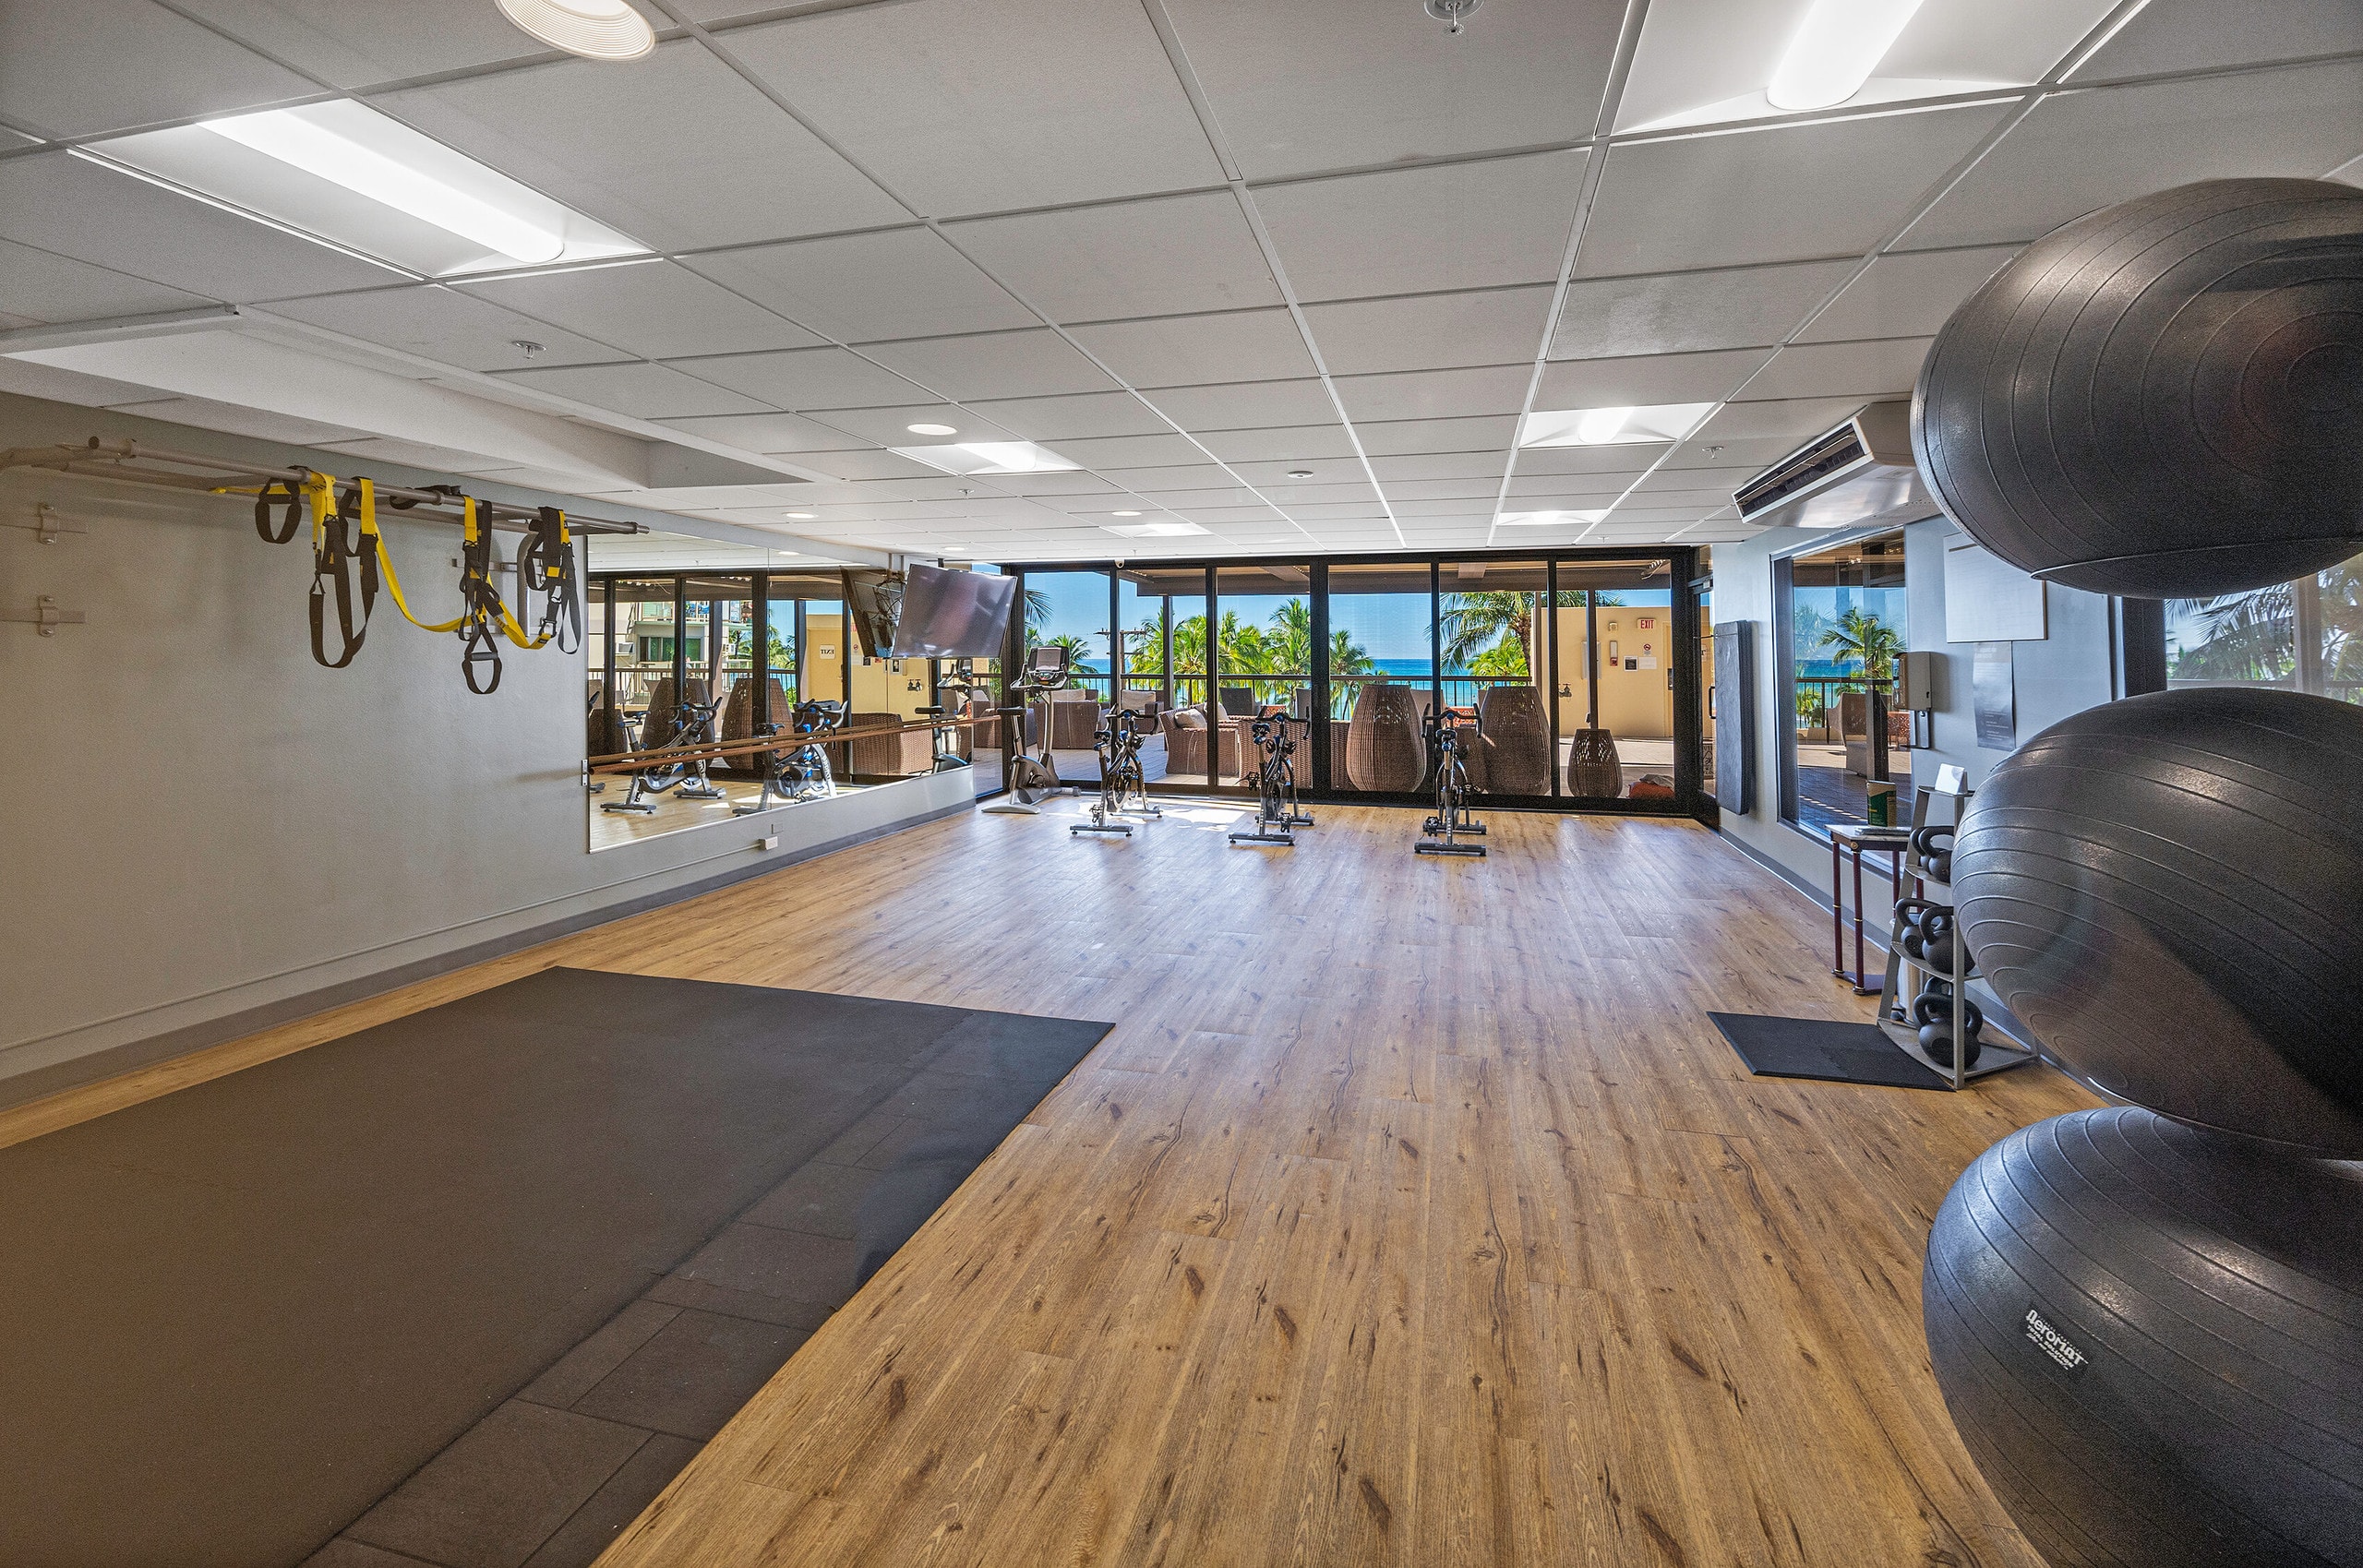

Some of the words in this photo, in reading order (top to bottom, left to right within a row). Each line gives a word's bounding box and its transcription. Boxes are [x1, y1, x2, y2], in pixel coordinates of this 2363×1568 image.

[1640, 619, 1654, 629] EXIT
[2027, 1324, 2044, 1342] TOTAL
[2044, 1340, 2075, 1368] SOLUTION
